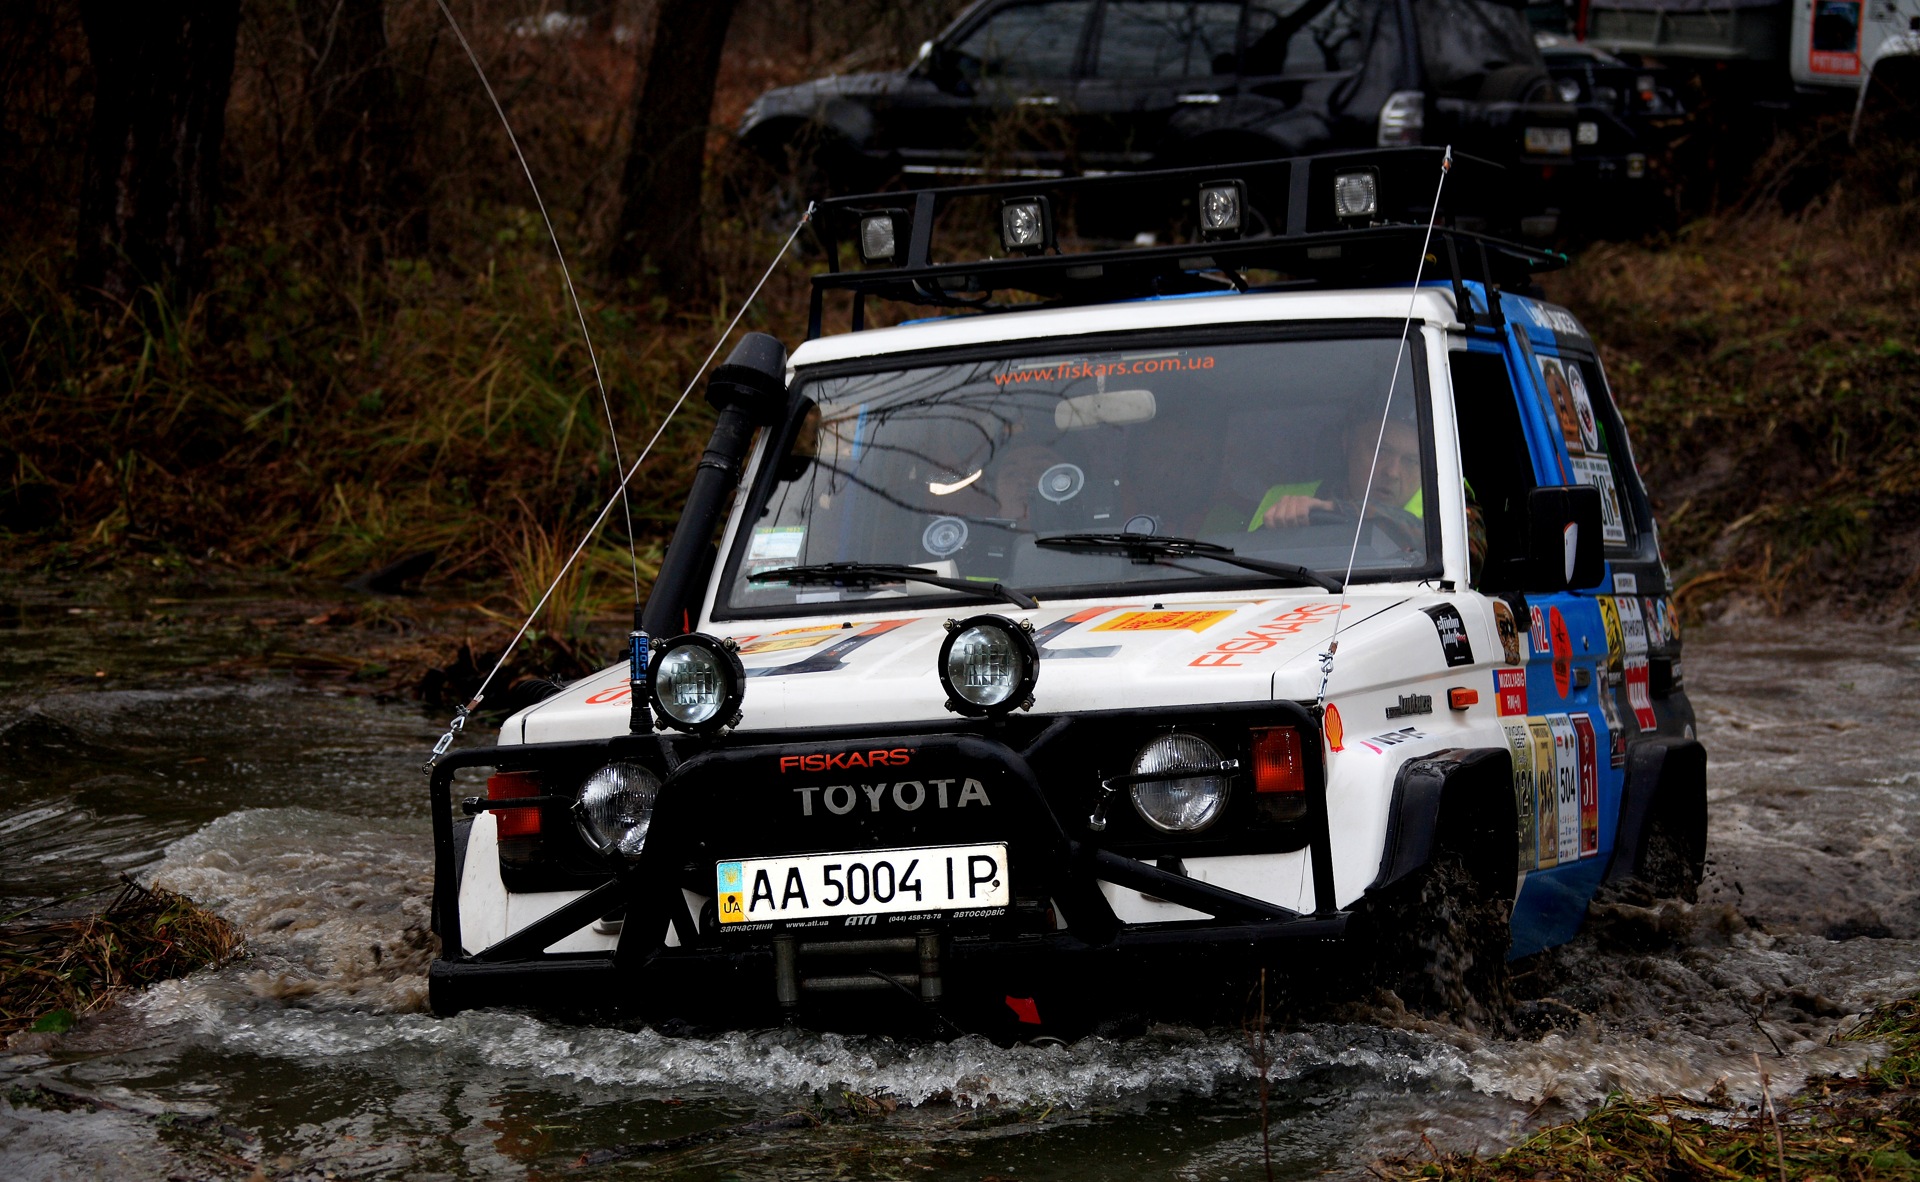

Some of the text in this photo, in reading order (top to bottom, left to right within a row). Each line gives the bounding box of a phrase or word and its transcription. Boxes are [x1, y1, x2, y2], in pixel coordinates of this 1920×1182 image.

[993, 356, 1215, 385] www.fiskars.com.ua
[780, 748, 909, 773] FISKARS
[793, 778, 991, 816] TOYOTA
[1560, 766, 1576, 804] 504
[820, 855, 922, 907] 5004
[723, 901, 742, 914] UA
[952, 906, 1006, 920] автосервіс
[719, 922, 773, 934] запчастини
[786, 919, 829, 929] www.atl.ua
